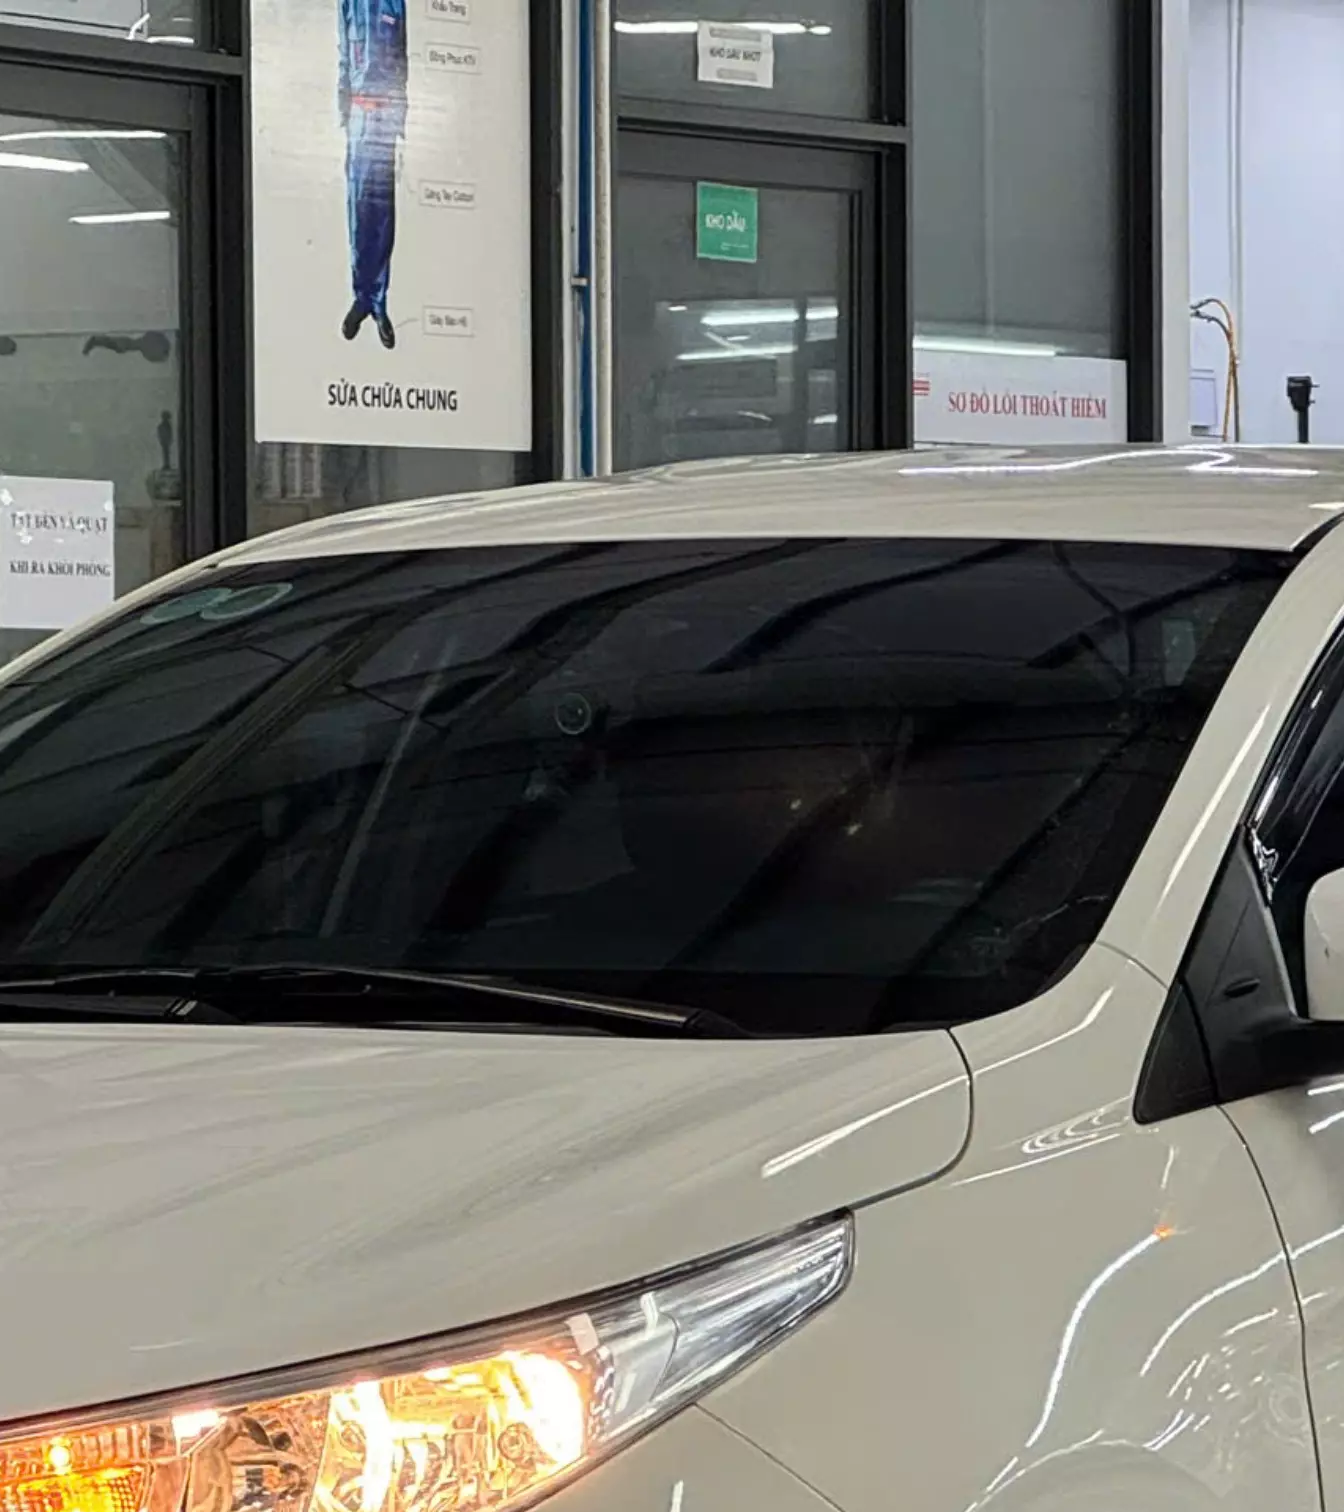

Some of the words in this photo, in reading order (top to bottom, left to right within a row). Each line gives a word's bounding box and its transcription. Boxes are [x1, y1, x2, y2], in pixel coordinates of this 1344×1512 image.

[328, 377, 358, 407] SỬA
[361, 381, 403, 409] CHỮA
[407, 387, 457, 411] CHUNG
[1020, 389, 1067, 418] THOÁT
[9, 560, 28, 574] KHI
[30, 560, 45, 575] RA
